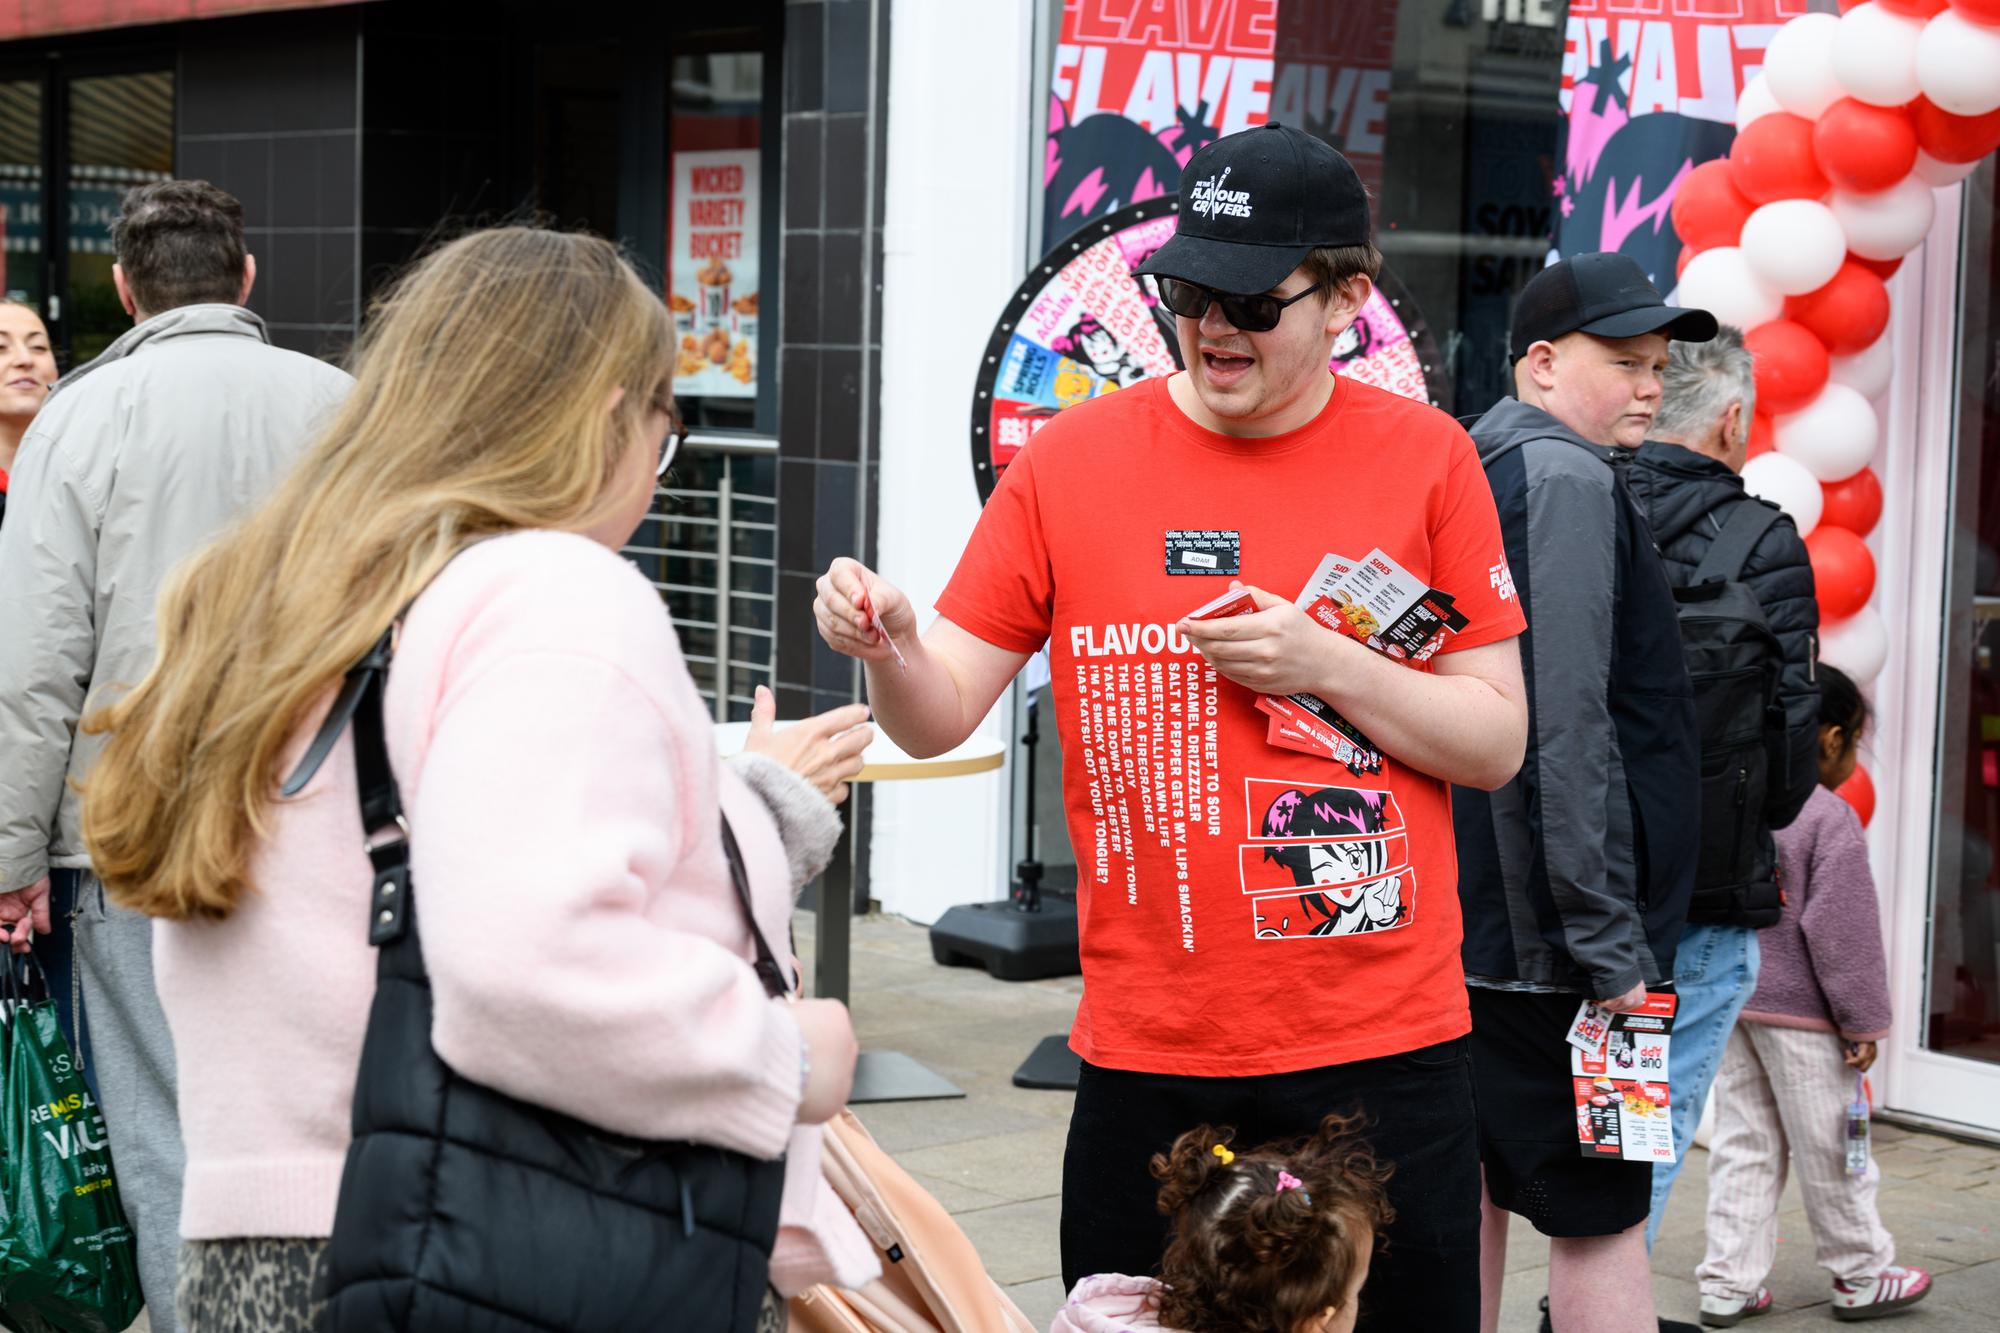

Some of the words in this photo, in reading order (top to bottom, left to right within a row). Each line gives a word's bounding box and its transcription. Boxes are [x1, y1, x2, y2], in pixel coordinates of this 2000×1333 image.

[690, 165, 743, 193] WICKED
[1190, 187, 1250, 205] FLAVOUR
[1192, 200, 1252, 218] CRAVERS
[688, 199, 745, 226] VARIETY
[690, 232, 742, 259] BUCKET
[1028, 293, 1053, 321] TRY
[1036, 294, 1074, 341] AGAIN
[1025, 355, 1047, 396] ROLLS
[1191, 556, 1210, 564] ADAM
[1333, 563, 1351, 574] SID
[1369, 558, 1393, 576] SIDES
[1421, 599, 1451, 620] DRINKS
[1070, 623, 1200, 657] FLAVOU
[1076, 665, 1087, 694] HAS
[1089, 665, 1100, 684] I'M
[1103, 664, 1115, 701] TAKE
[1118, 664, 1130, 692] THE
[1168, 662, 1181, 698] SALT
[1092, 690, 1101, 699] A
[1134, 663, 1147, 716] YOU'RE
[1186, 662, 1200, 730] CARAMEL
[1205, 689, 1217, 716] TOO
[1079, 698, 1091, 744] KATSU
[1106, 705, 1116, 726] ME
[1170, 703, 1182, 717] N'
[1093, 703, 1106, 753] SMOKY
[1120, 697, 1132, 754] NOODLE
[1136, 720, 1147, 730] A
[1330, 733, 1339, 744] TO
[1107, 731, 1121, 771] DOWN
[1170, 721, 1182, 776] PEPPER
[1205, 721, 1217, 769] SWEET
[1084, 748, 1097, 776] GOT
[1124, 759, 1136, 788] GUY
[1098, 757, 1114, 800] SEOUL
[1114, 776, 1125, 793] TO
[1136, 734, 1155, 833] FIRECRACKER
[1154, 762, 1167, 812] PRAWN
[1206, 773, 1219, 791] TO
[1088, 780, 1104, 816] YOUR
[1171, 780, 1184, 818] GETS
[1106, 805, 1121, 853] SISTER
[1118, 798, 1135, 861] TERIYAKI
[1207, 796, 1220, 836] SOUR
[1158, 818, 1170, 847] LIFE
[1173, 823, 1186, 843] MY
[1095, 820, 1108, 884] TONGUE?
[1175, 848, 1188, 880] LIPS
[1126, 865, 1137, 905] TOWN
[1178, 884, 1195, 952] SMACKIN'
[1640, 1046, 1662, 1057] APP
[1640, 1058, 1662, 1069] OUR
